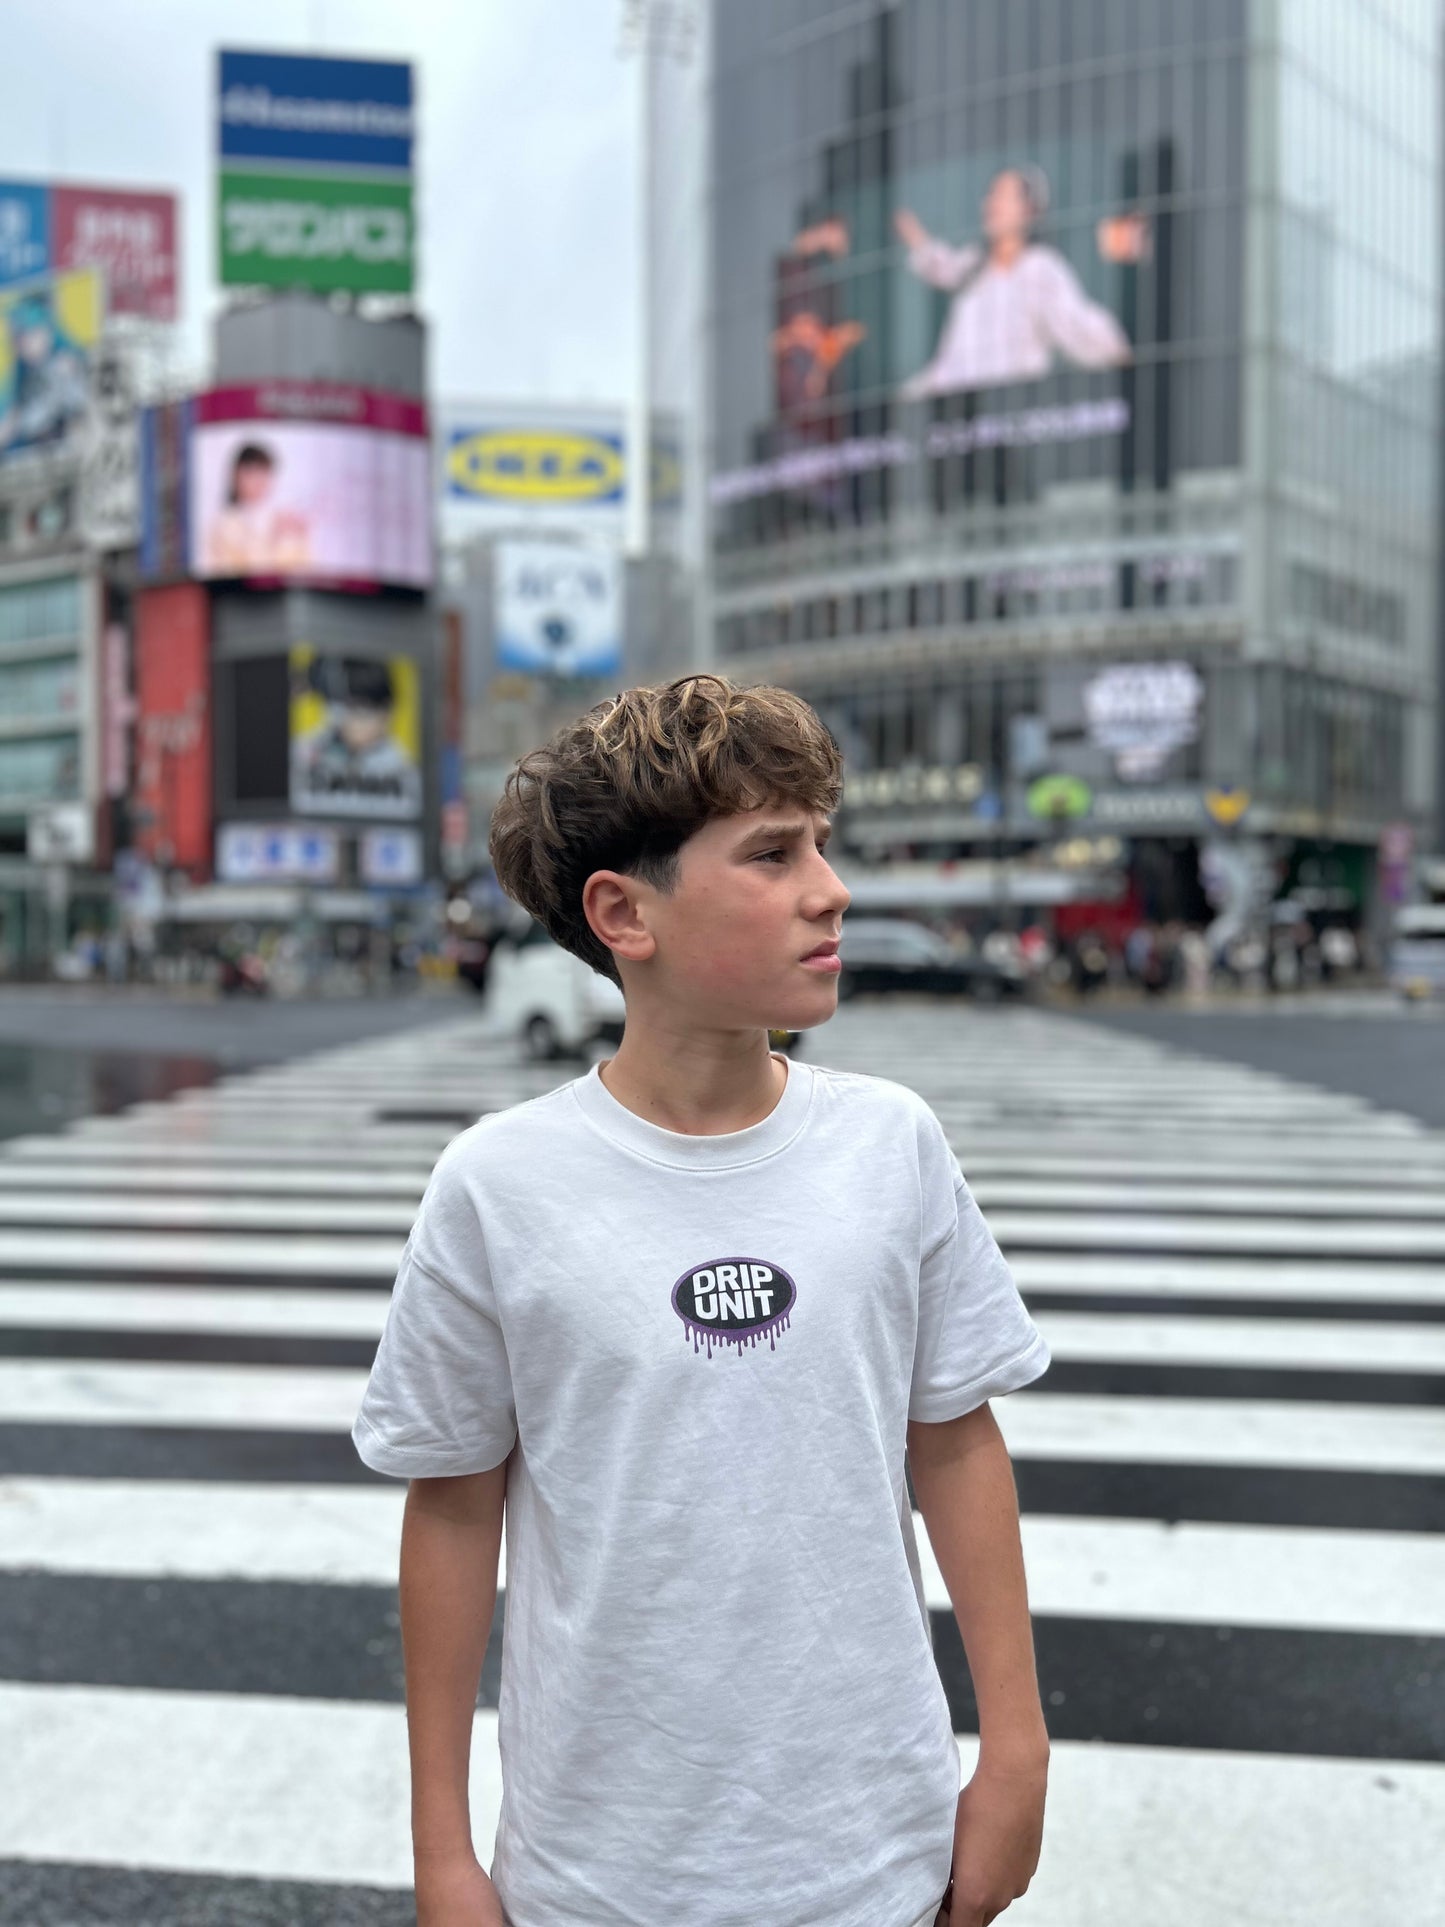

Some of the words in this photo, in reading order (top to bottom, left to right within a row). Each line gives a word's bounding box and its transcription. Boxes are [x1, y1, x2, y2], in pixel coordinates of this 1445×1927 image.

[466, 448, 608, 483] IKEA
[692, 1264, 773, 1296] DRIP
[694, 1290, 774, 1321] UNIT
